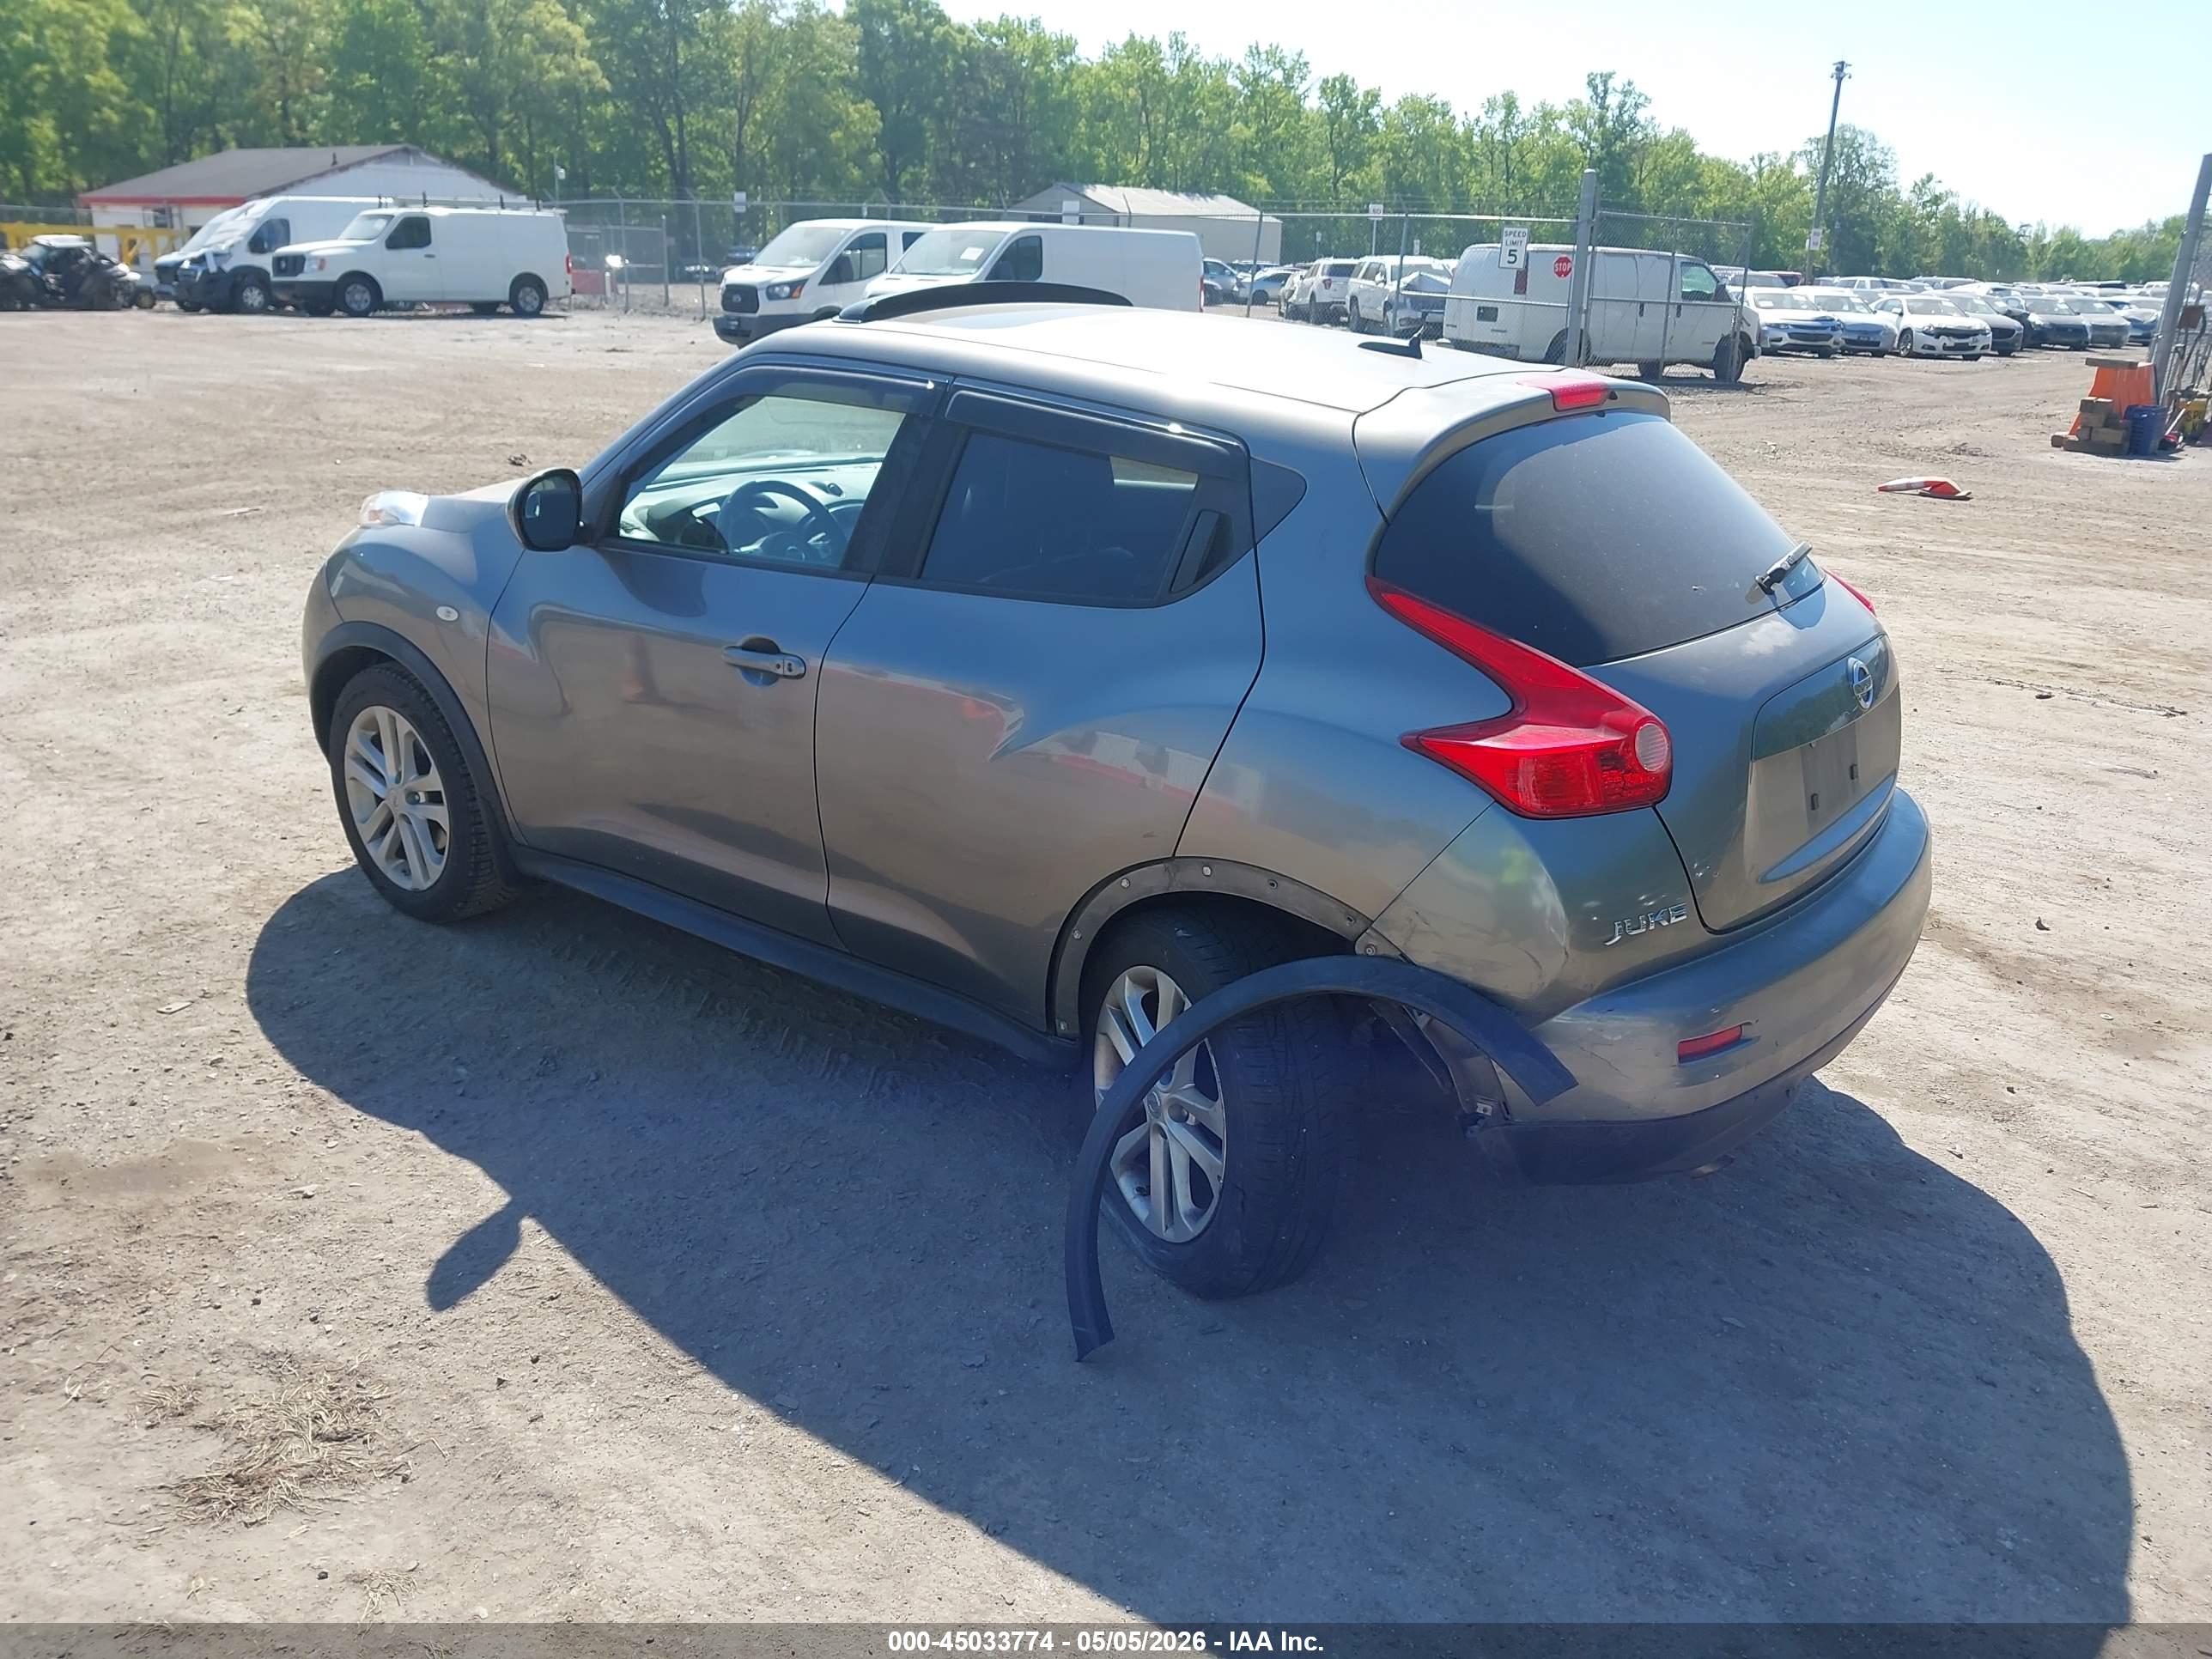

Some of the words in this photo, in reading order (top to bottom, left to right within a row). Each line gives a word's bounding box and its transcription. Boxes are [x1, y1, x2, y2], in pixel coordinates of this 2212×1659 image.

[1507, 249, 1517, 264] 5
[1555, 262, 1572, 273] STOP
[1603, 902, 1687, 945] JUKE
